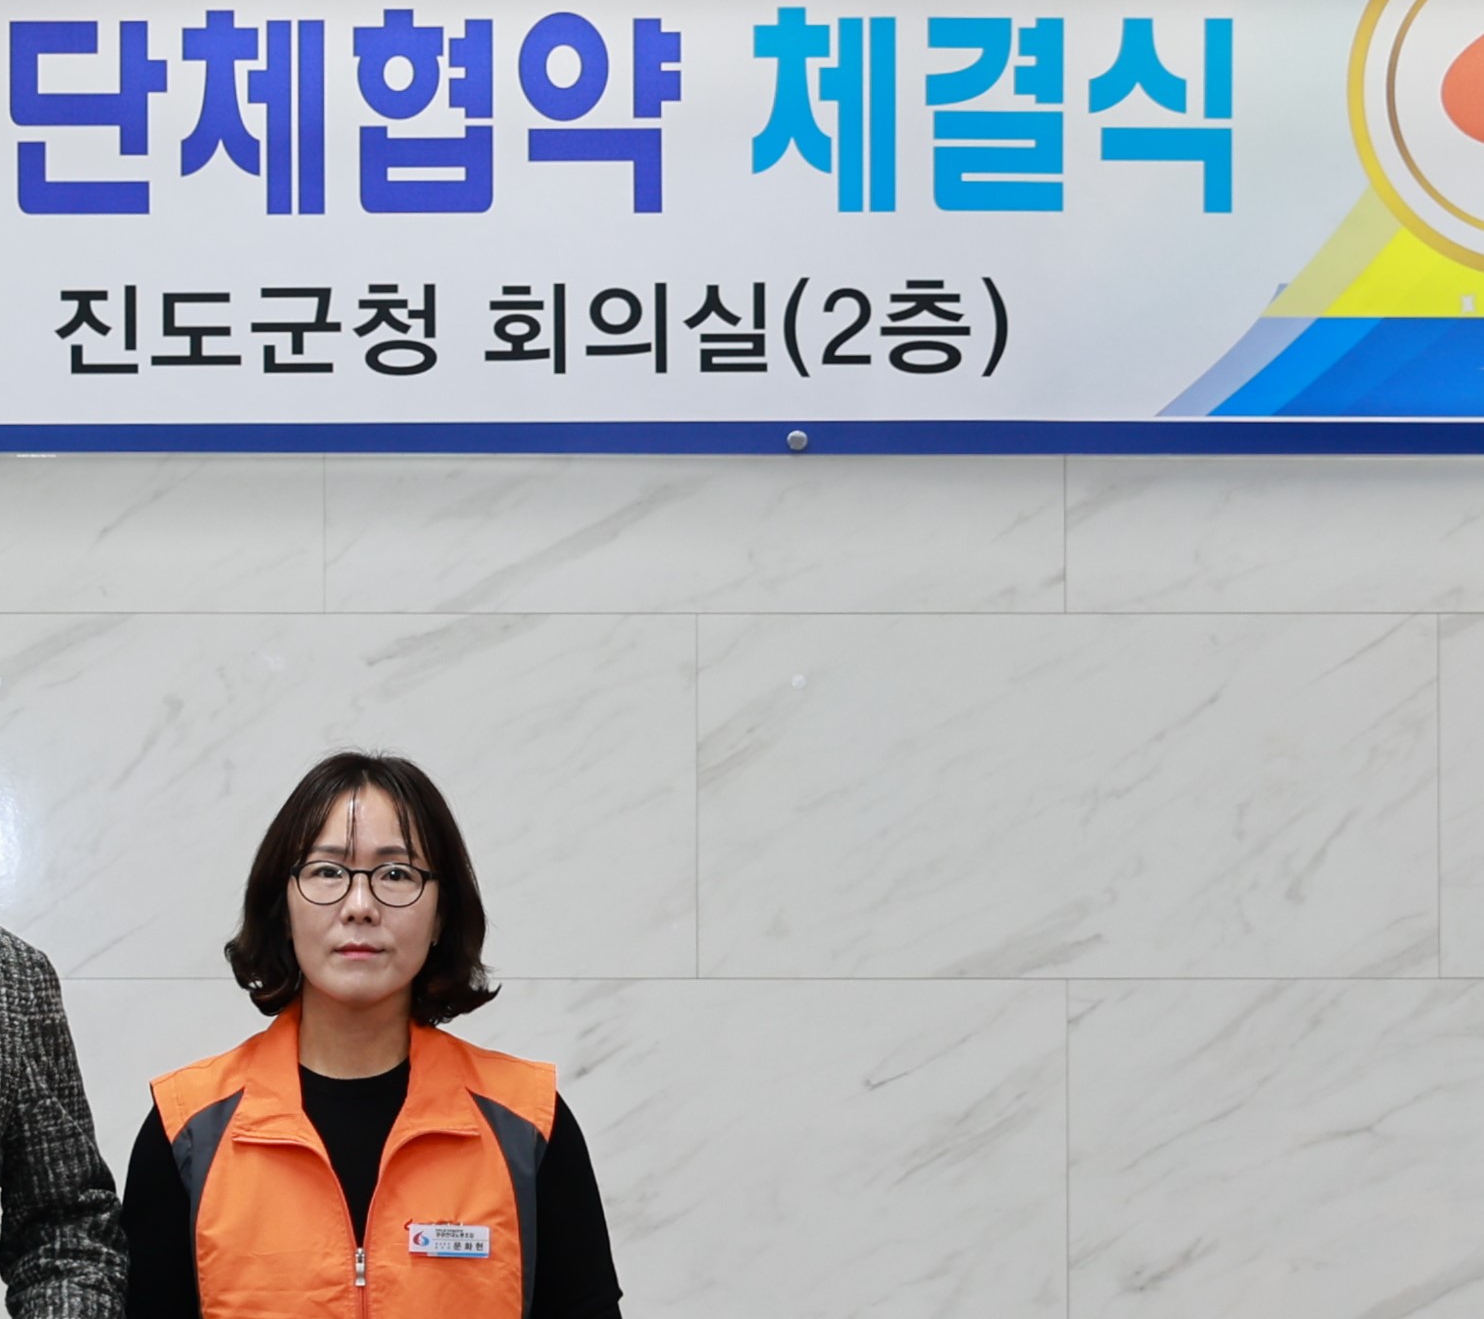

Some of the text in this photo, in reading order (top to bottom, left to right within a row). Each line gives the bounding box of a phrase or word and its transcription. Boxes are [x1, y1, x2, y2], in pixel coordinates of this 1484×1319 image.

[8, 9, 682, 216] 단체협약
[751, 7, 1234, 214] 체결식
[54, 283, 438, 377] 진도군청
[484, 276, 1009, 378] 회의실(2층)
